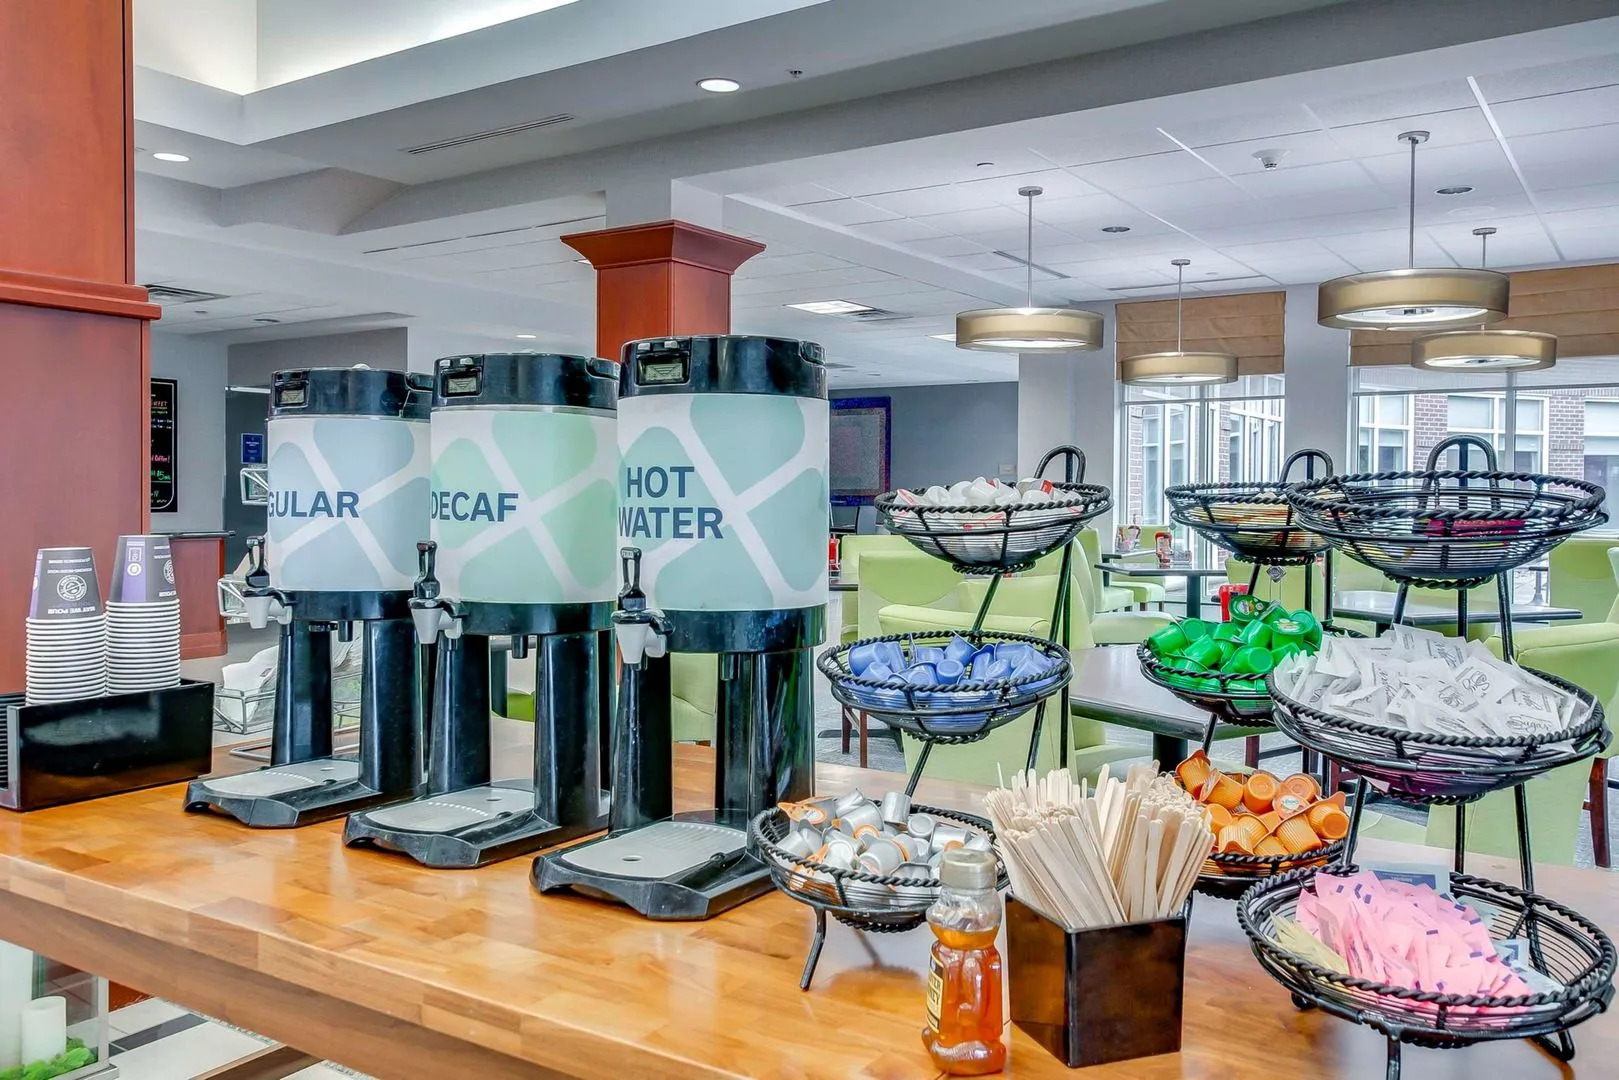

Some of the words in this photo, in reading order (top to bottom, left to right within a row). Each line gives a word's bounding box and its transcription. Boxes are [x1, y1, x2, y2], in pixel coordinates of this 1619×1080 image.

[627, 466, 695, 498] HOT
[268, 490, 360, 518] GULAR
[431, 490, 519, 522] DECAF
[618, 506, 724, 539] WATER
